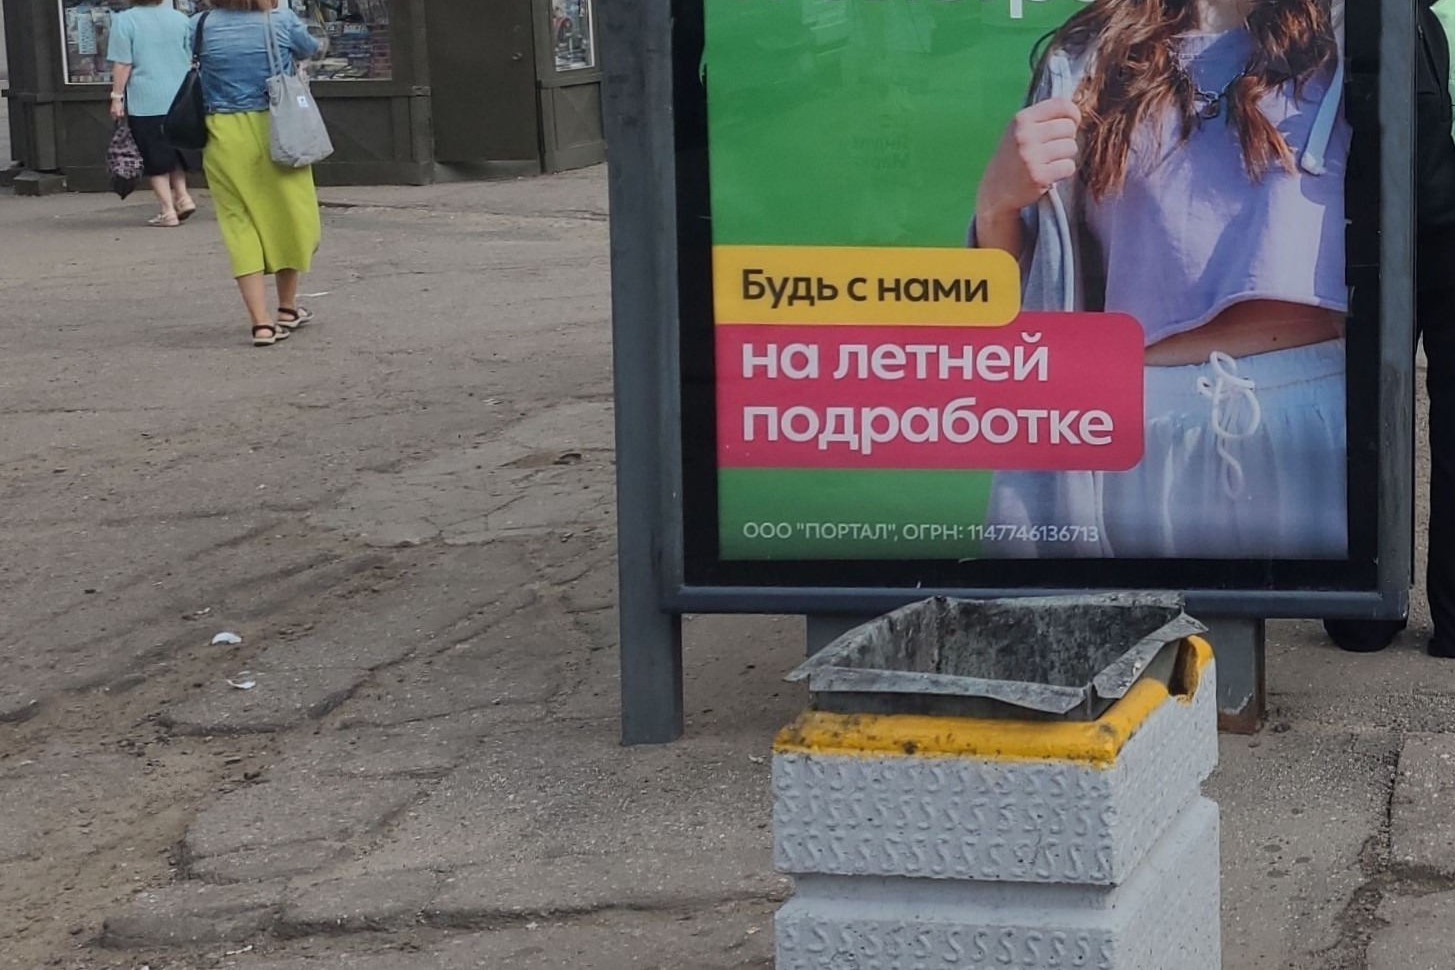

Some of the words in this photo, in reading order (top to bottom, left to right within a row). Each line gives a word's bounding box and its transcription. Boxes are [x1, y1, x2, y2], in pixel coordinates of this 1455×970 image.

[742, 269, 839, 307] Будь
[846, 276, 868, 302] с
[876, 276, 989, 303] нами
[742, 342, 820, 380] на
[832, 329, 1048, 382] летней
[742, 396, 1114, 455] подработке
[743, 522, 792, 539] ООО
[797, 522, 899, 542] "ПОРТАЛ",
[902, 523, 964, 541] ОГРН:
[968, 525, 1099, 542] 1147746136713
